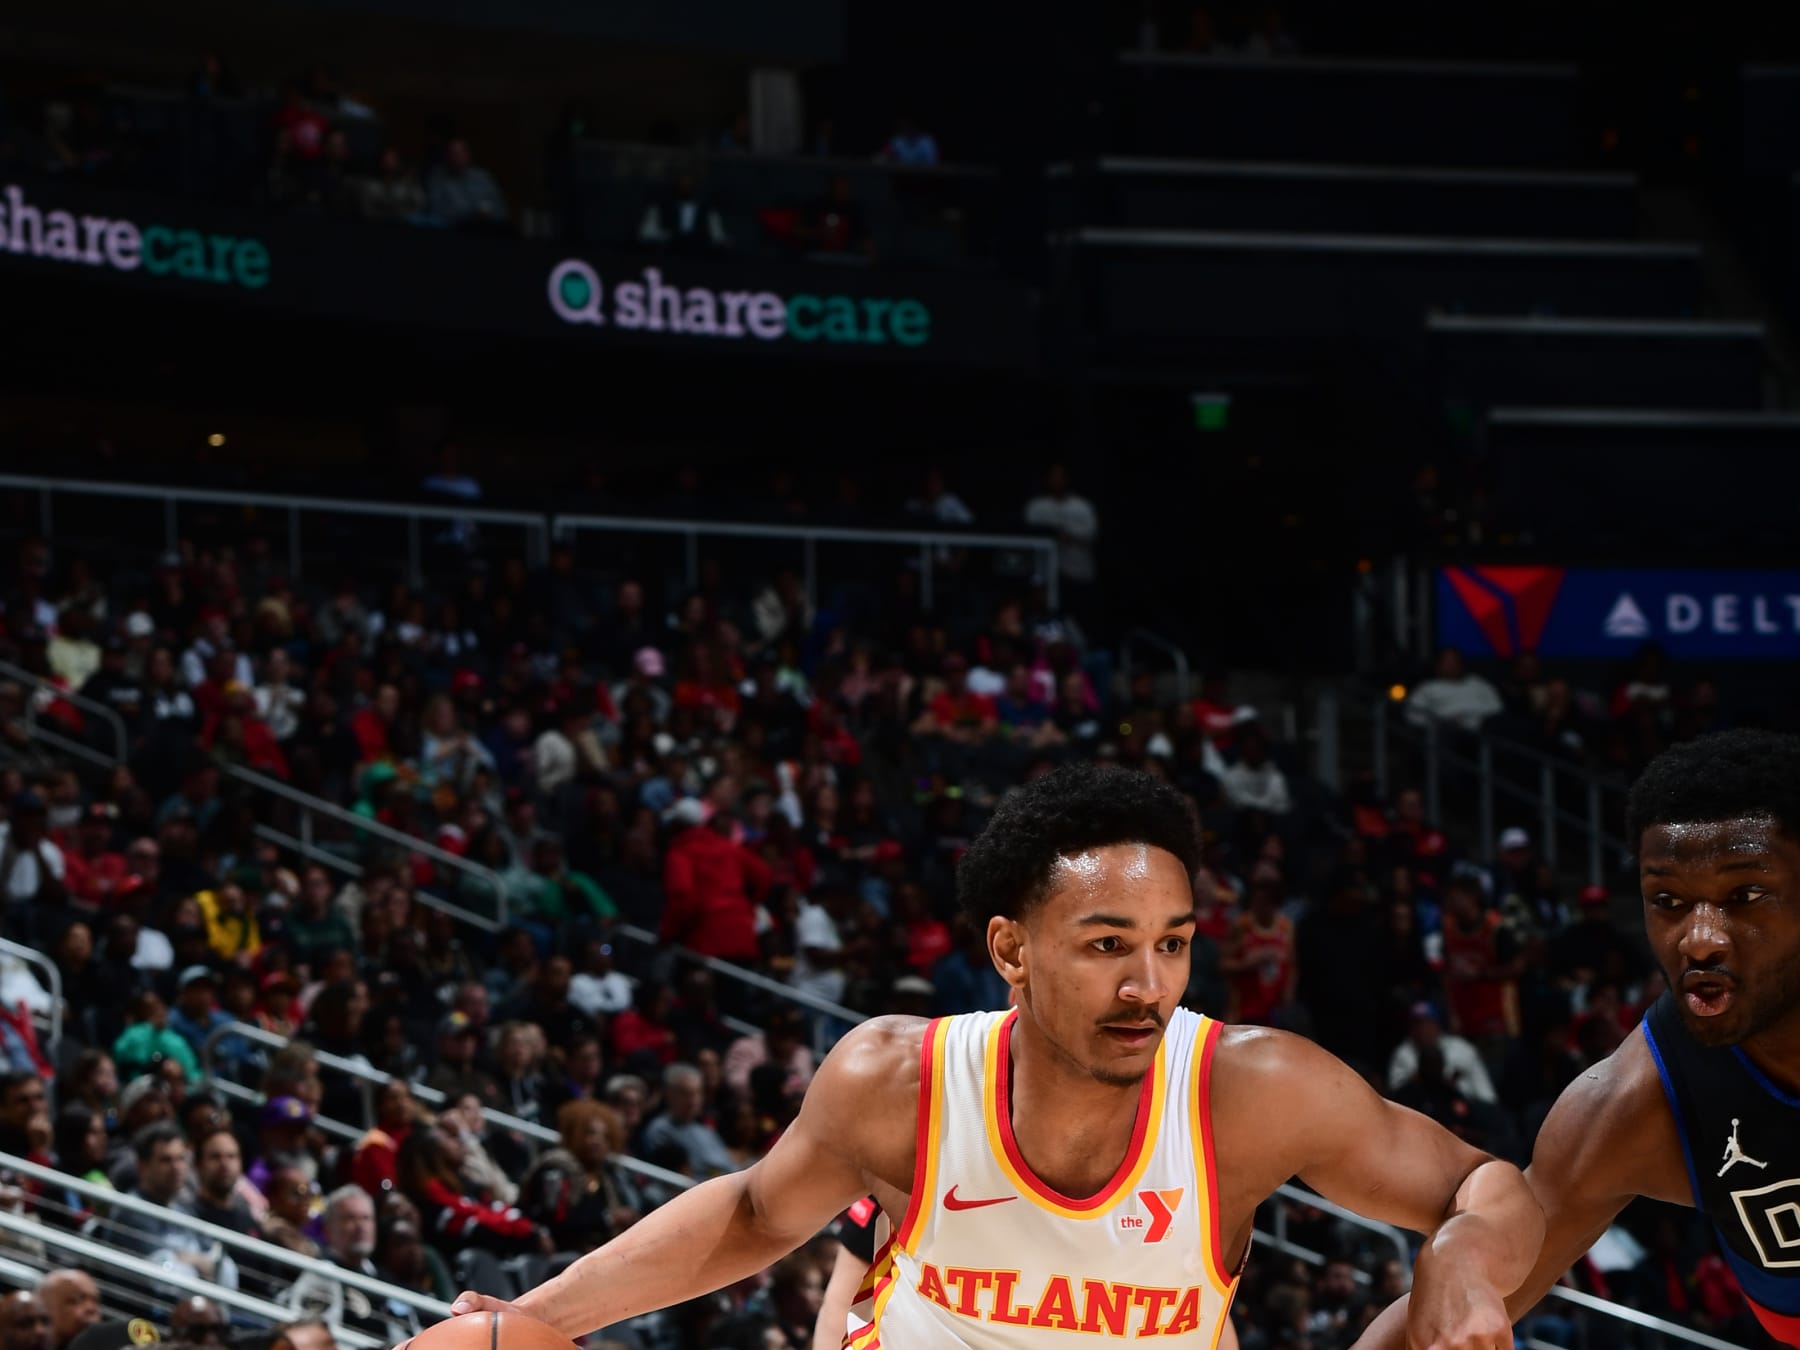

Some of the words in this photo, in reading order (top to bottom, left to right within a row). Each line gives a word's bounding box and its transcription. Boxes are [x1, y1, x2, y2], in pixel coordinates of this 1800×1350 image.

[614, 266, 930, 346] sharecare
[1120, 1216, 1143, 1229] the
[917, 1261, 1202, 1340] ATLANTA
